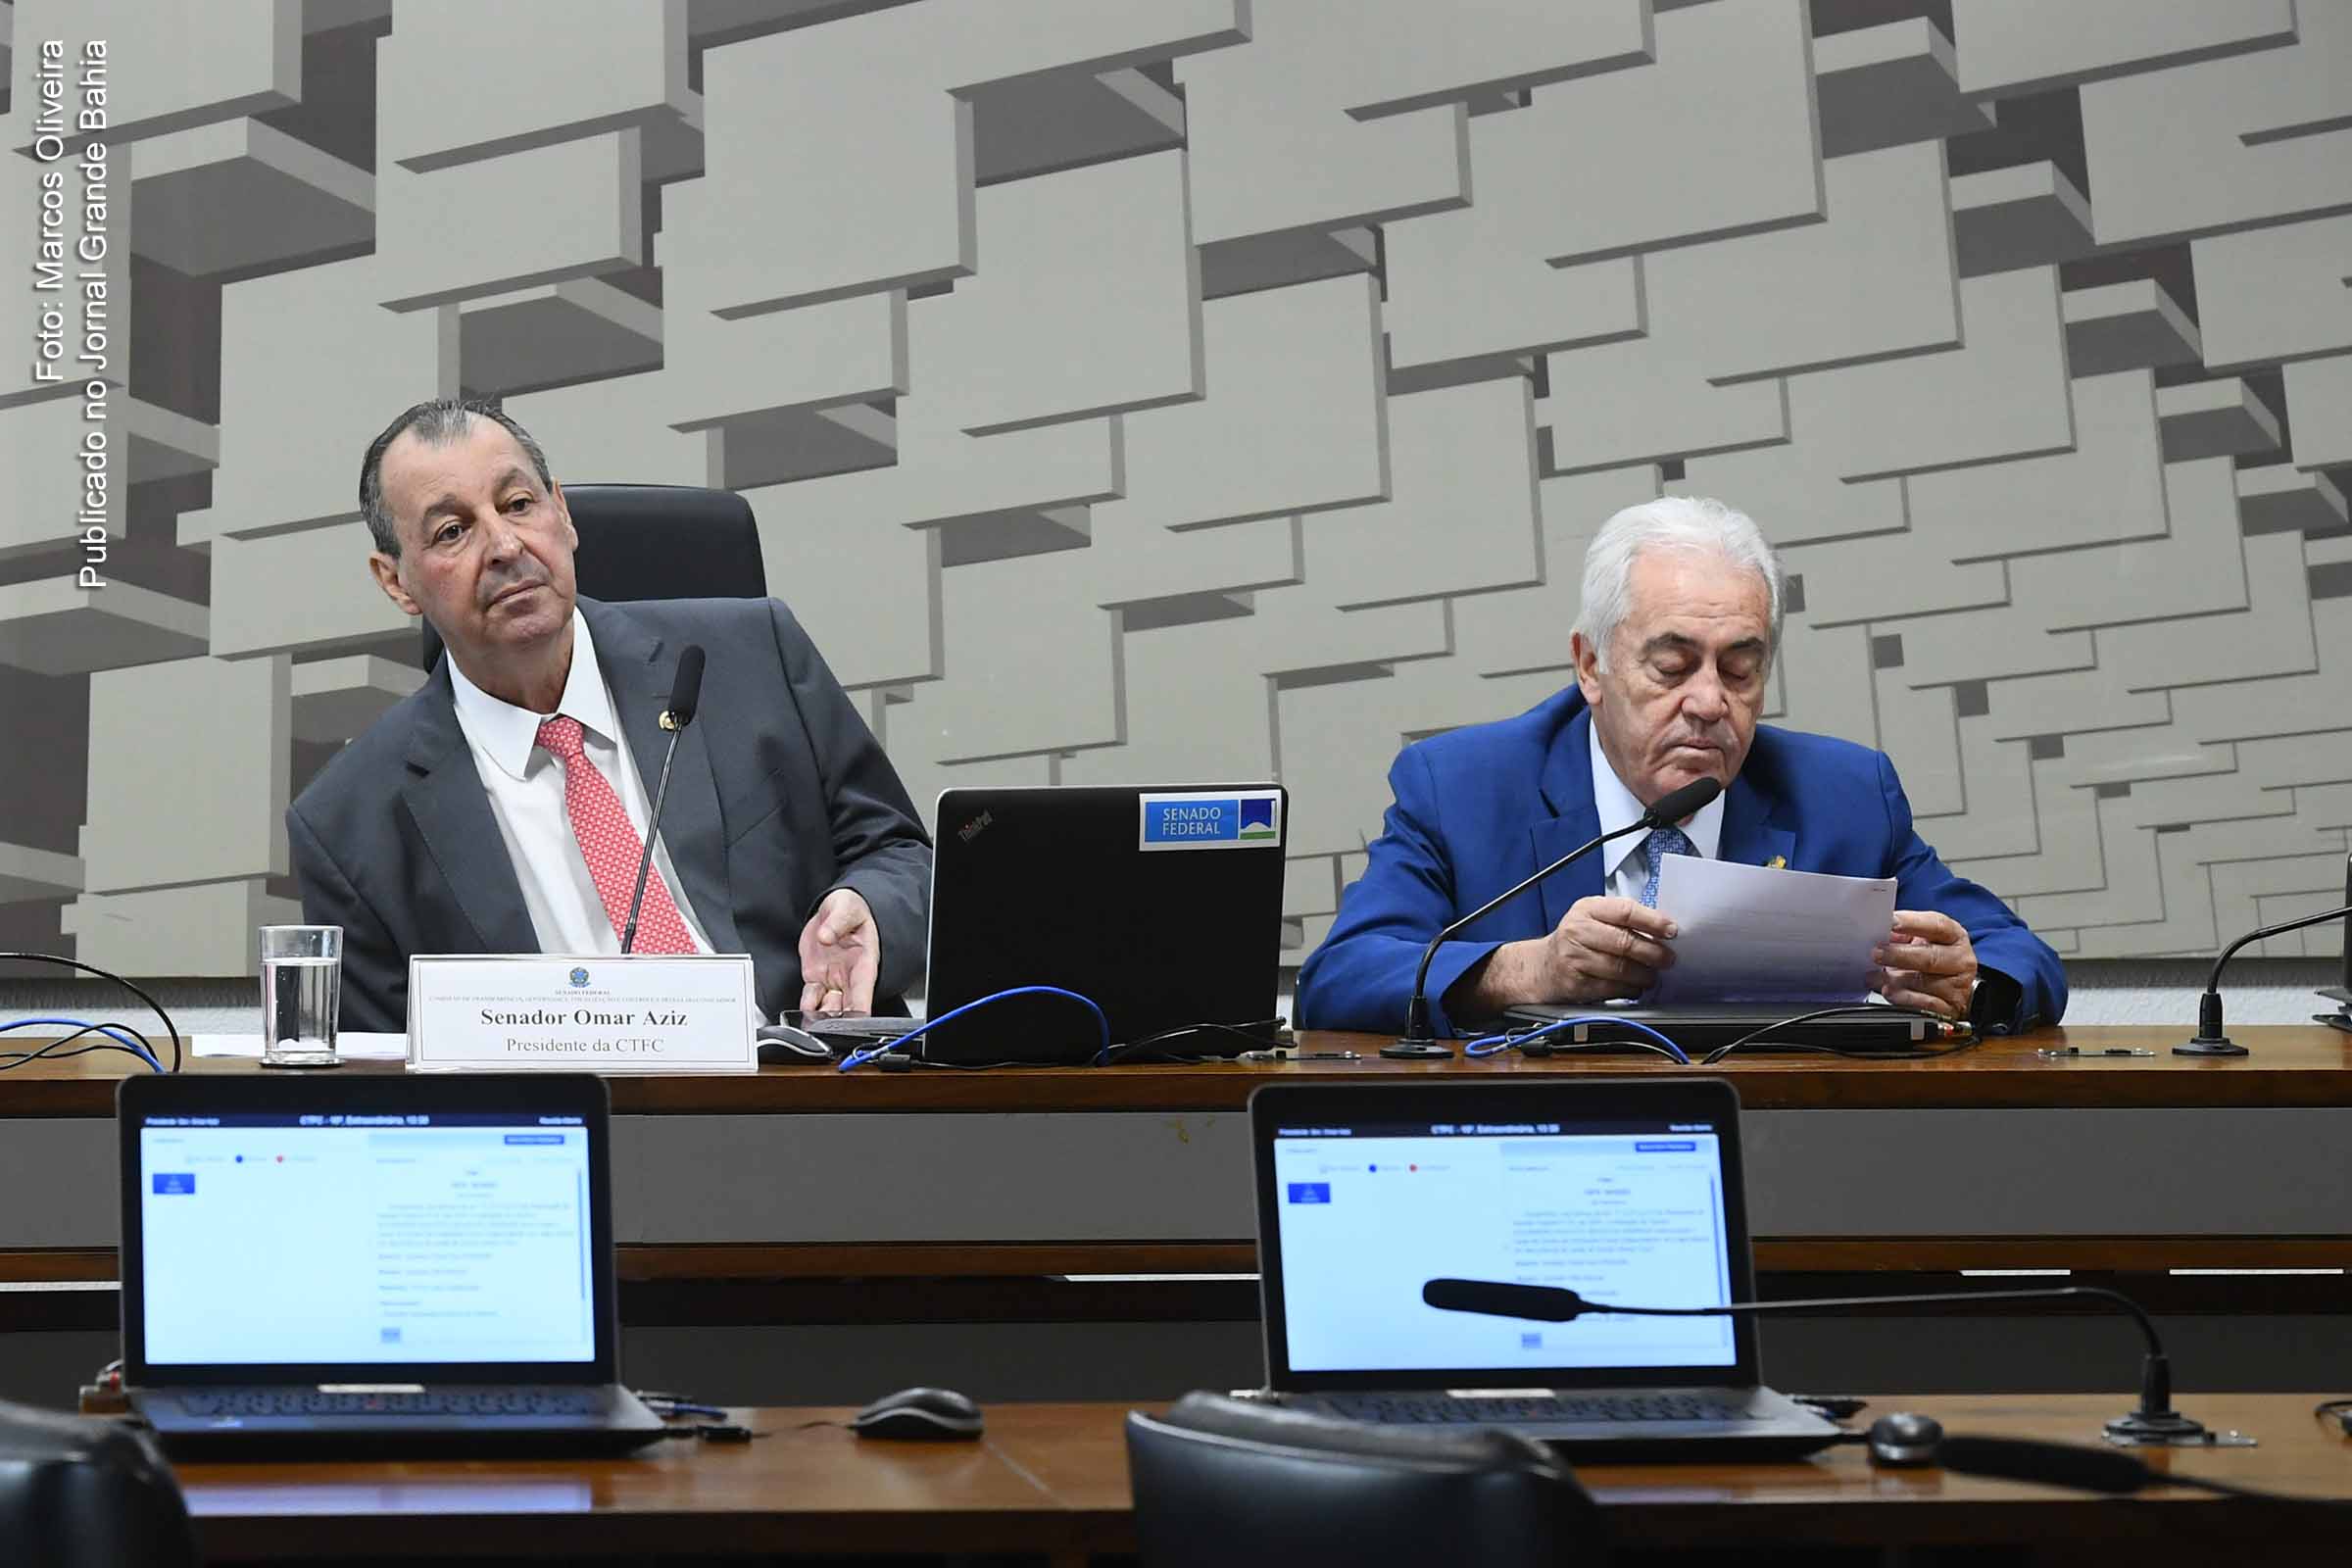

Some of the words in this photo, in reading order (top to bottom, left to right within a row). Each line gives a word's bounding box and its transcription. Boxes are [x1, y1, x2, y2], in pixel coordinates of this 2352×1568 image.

[1163, 807, 1221, 820] SENADO
[1162, 822, 1221, 835] FEDERAL
[480, 1008, 567, 1025] Senador
[574, 1008, 636, 1025] Omar
[643, 1009, 689, 1026] Aziz
[506, 1038, 588, 1052] Presidente
[592, 1038, 612, 1052] da
[615, 1038, 664, 1052] CTFC
